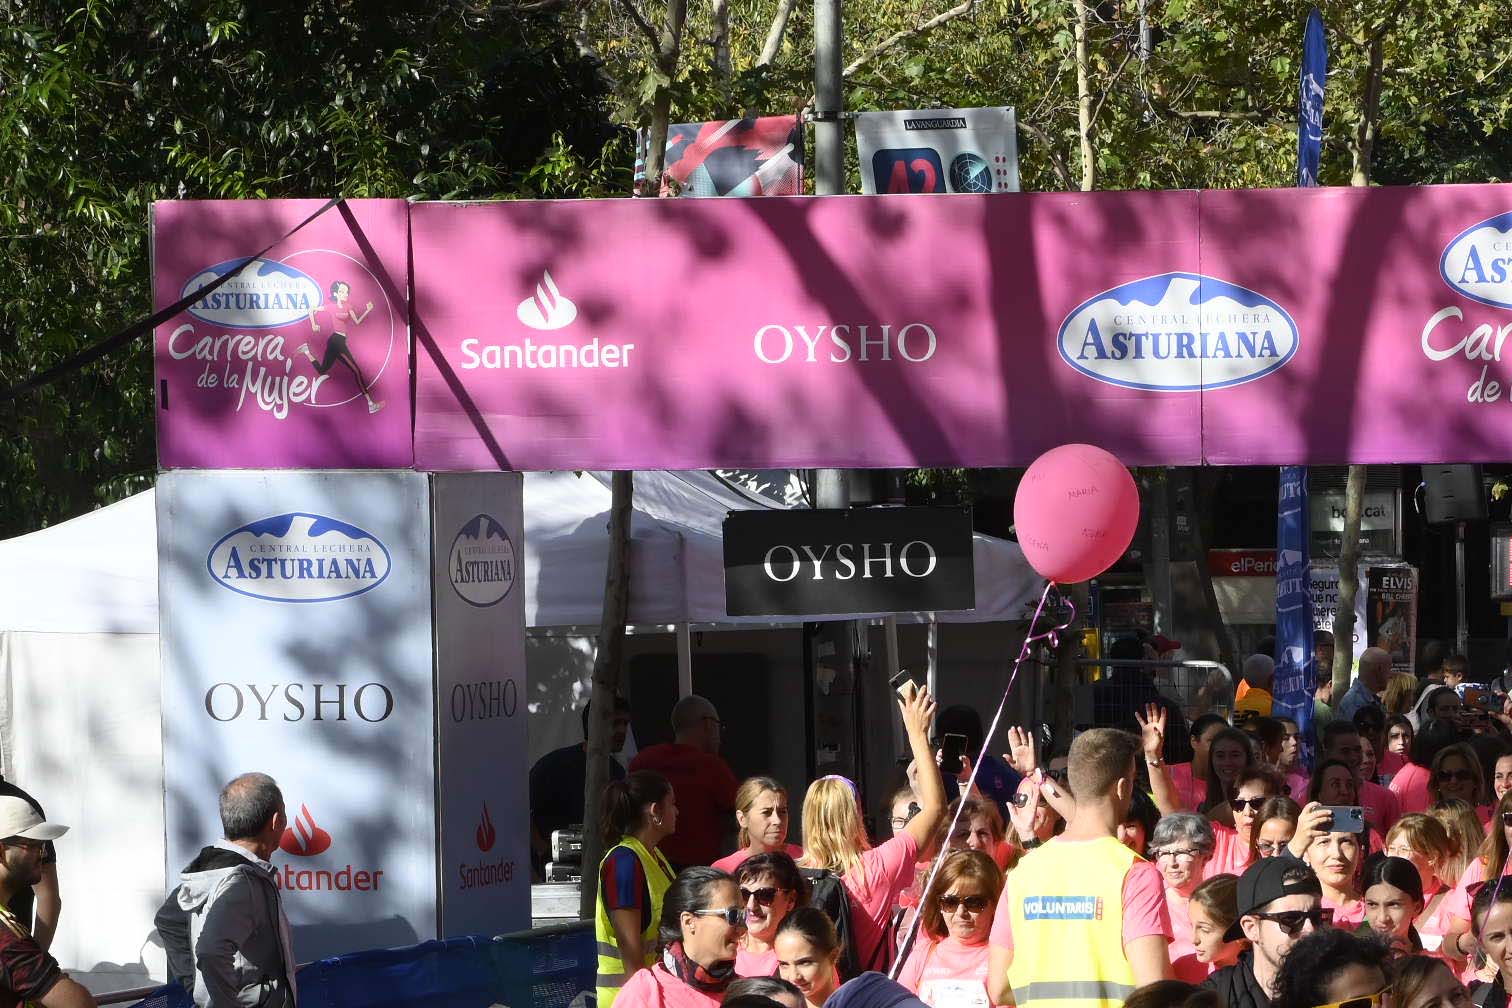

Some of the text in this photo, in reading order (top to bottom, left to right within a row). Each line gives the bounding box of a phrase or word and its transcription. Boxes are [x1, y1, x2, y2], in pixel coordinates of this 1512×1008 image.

[1076, 317, 1280, 361] ASTURIANA
[1114, 314, 1188, 326] CENTRAL
[168, 323, 285, 361] Carrera
[460, 337, 634, 372] Santander
[753, 322, 937, 365] OYSHO
[197, 359, 331, 420] de la Mujer
[1467, 364, 1502, 403] de
[221, 546, 379, 581] ASTURIANA
[249, 543, 372, 554] CENTRAL LECHERA
[453, 549, 513, 586] ASTURIANA
[762, 540, 938, 582] OYSHO
[204, 682, 395, 724] OYSHO
[450, 678, 518, 724] OYSHO
[275, 864, 385, 892] ntander
[459, 859, 516, 890] Santander
